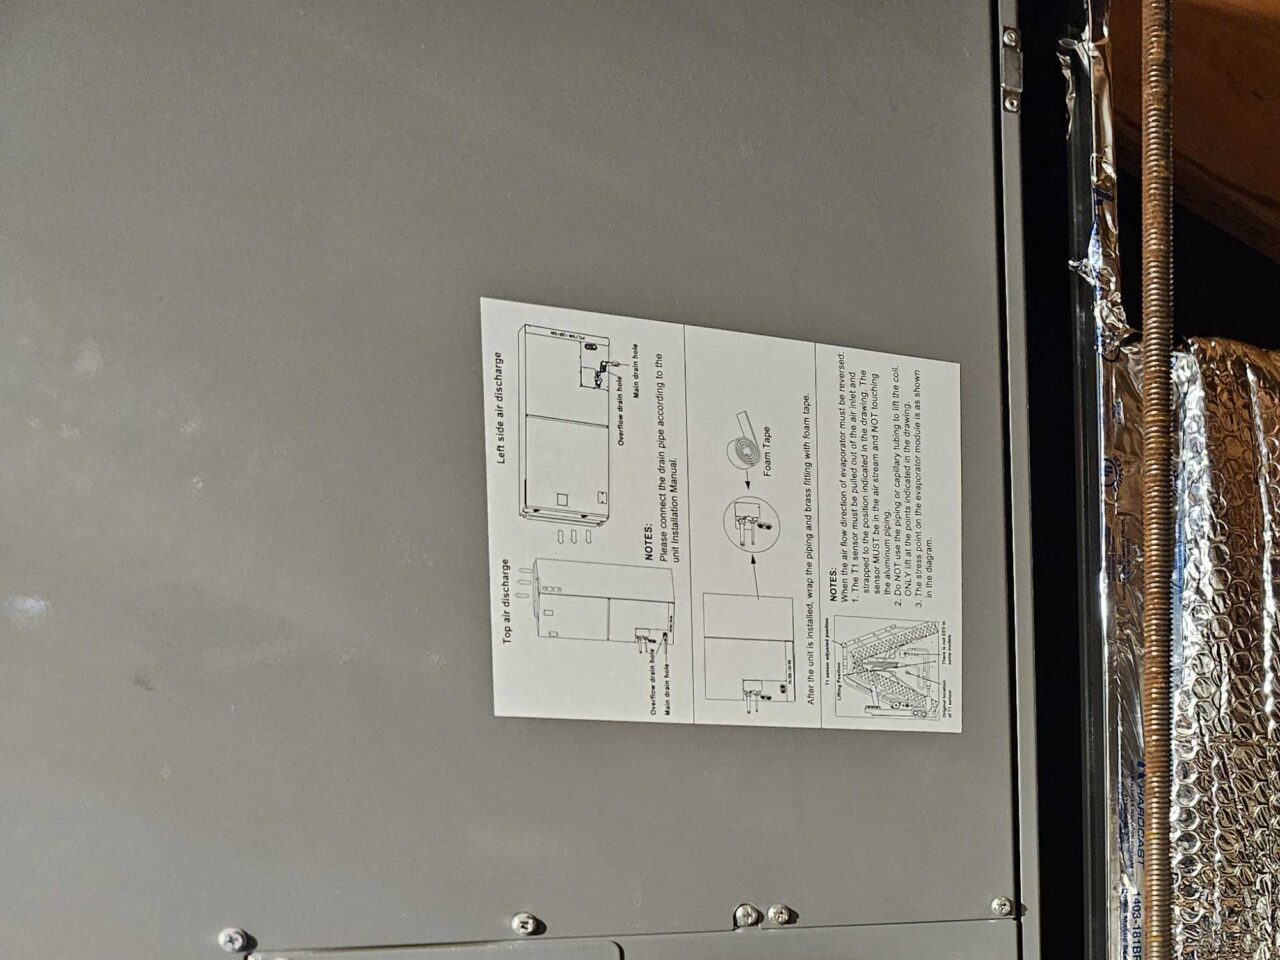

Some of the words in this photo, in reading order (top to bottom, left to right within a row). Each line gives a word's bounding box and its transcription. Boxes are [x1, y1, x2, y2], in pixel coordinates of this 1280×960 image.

[654, 353, 663, 368] the
[494, 352, 504, 402] discharge
[655, 370, 663, 379] to
[837, 352, 845, 392] reversed:
[848, 372, 856, 388] and
[859, 370, 867, 386] The
[891, 365, 899, 383] coil.
[615, 376, 623, 392] hole
[870, 373, 879, 410] touching
[656, 382, 665, 427] according
[803, 393, 811, 414] tape.
[838, 394, 845, 405] be
[860, 390, 869, 426] drawing.
[914, 400, 920, 410] as
[494, 404, 504, 418] air
[838, 408, 846, 429] must
[849, 410, 857, 423] air
[892, 413, 900, 421] to
[903, 402, 911, 437] drawing.
[496, 421, 505, 442] side
[802, 417, 810, 439] foam
[849, 425, 857, 438] the
[870, 412, 878, 432] NOT
[656, 429, 667, 449] pipe
[762, 426, 772, 449] Tape
[849, 440, 857, 449] of
[860, 428, 868, 442] the
[871, 435, 879, 451] and
[892, 424, 902, 450] tubing
[913, 422, 921, 453] module
[496, 445, 505, 464] Left
[803, 442, 811, 459] with
[839, 431, 848, 477] evaporator
[860, 444, 868, 452] in
[903, 439, 911, 453] the
[657, 451, 666, 474] drain
[763, 452, 771, 477] Foam
[893, 452, 902, 488] capillary
[658, 476, 666, 491] the
[669, 458, 678, 493] Manual.
[803, 462, 812, 485] fitting
[838, 479, 847, 488] of
[850, 468, 859, 494] pulled
[804, 488, 812, 512] brass
[850, 496, 858, 507] be
[894, 490, 900, 499] or
[659, 493, 667, 529] connect
[861, 495, 870, 528] position
[893, 501, 902, 527] piping
[904, 506, 912, 531] points
[914, 503, 922, 516] the
[670, 496, 679, 544] Installation
[804, 515, 812, 531] and
[872, 524, 880, 535] be
[883, 509, 892, 537] piping.
[915, 519, 922, 529] on
[644, 523, 653, 561] NOTES:
[659, 531, 668, 562] Please
[805, 533, 814, 559] piping
[840, 529, 848, 546] flow
[915, 531, 923, 552] point
[671, 547, 680, 563] unit
[840, 549, 848, 560] air
[862, 546, 869, 554] to
[872, 537, 880, 564] MUST
[883, 539, 891, 580] aluminum
[905, 549, 912, 557] at
[925, 537, 934, 573] diagram.
[805, 562, 813, 575] the
[840, 563, 848, 575] the
[851, 564, 859, 574] T1
[893, 562, 901, 582] NOT
[904, 559, 912, 569] lift
[501, 559, 511, 607] discharge
[829, 568, 837, 602] NOTES:
[851, 577, 859, 593] The
[862, 557, 871, 594] strapped
[904, 571, 912, 596] ONLY
[893, 584, 902, 596] Do
[915, 600, 922, 608] 3.
[502, 610, 511, 623] air
[806, 602, 814, 639] installed,
[502, 625, 513, 644] Top
[807, 669, 815, 682] the
[807, 684, 815, 705] After
